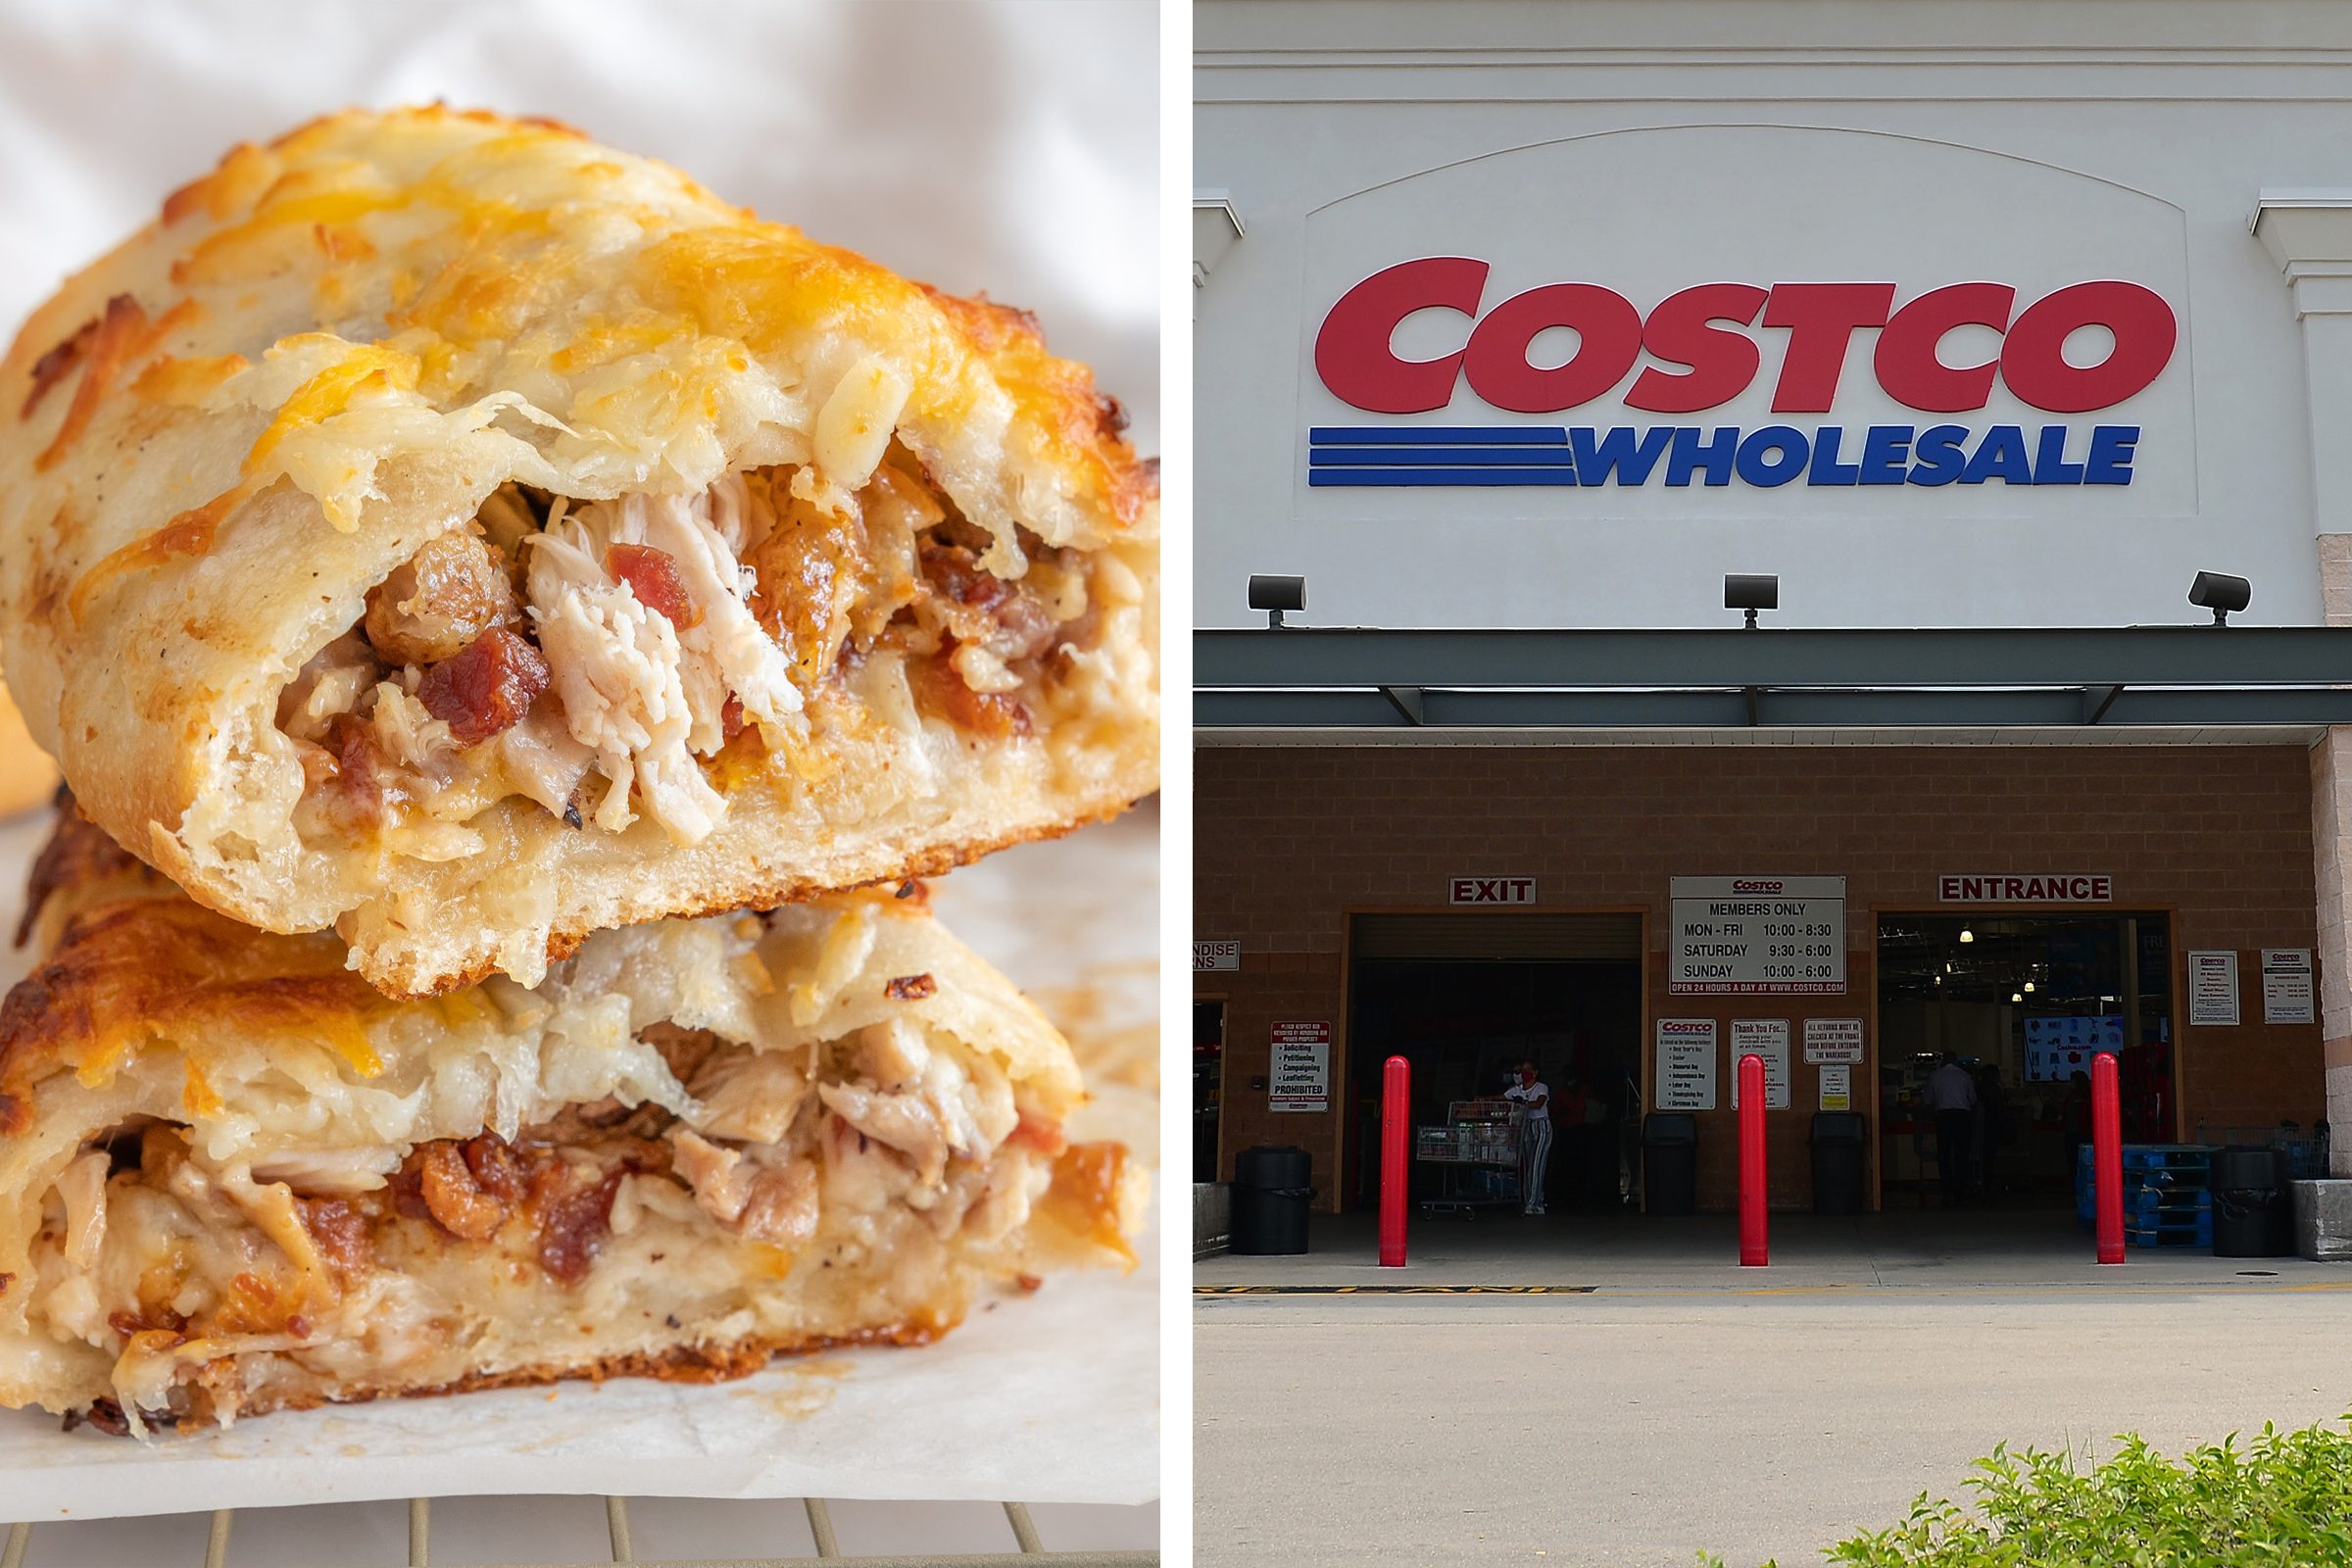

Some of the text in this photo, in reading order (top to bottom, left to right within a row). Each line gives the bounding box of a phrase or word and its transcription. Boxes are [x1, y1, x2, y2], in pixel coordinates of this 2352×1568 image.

[1314, 256, 2178, 414] COSTCO
[1568, 425, 2141, 488] WHOLESALE
[1733, 880, 1783, 890] COSTCO
[1941, 877, 2110, 900] ENTRANCE
[1454, 880, 1532, 902] EXIT
[1710, 904, 1806, 915] MEMBERS ONLY
[1685, 924, 1712, 936] MON
[1724, 924, 1742, 936] FRI
[1764, 924, 1794, 936] 10:00
[1806, 924, 1832, 936] 8:30
[1685, 945, 1748, 956] SATURDAY
[1770, 945, 1794, 956] 9:30
[1806, 945, 1832, 956] 6:00
[1194, 956, 1215, 968] NS
[1685, 965, 1733, 977] SUNDAY
[1764, 965, 1794, 977] 10:00
[1806, 965, 1832, 977] 6:00
[1672, 983, 1844, 992] OPEN 24 HOURS A DAY AT WWW.COSTCO.COM
[1662, 1022, 1712, 1031] COSTCO
[1735, 1024, 1754, 1033] Thank
[1756, 1024, 1767, 1033] You
[1275, 1085, 1322, 1095] PROHIBITED
